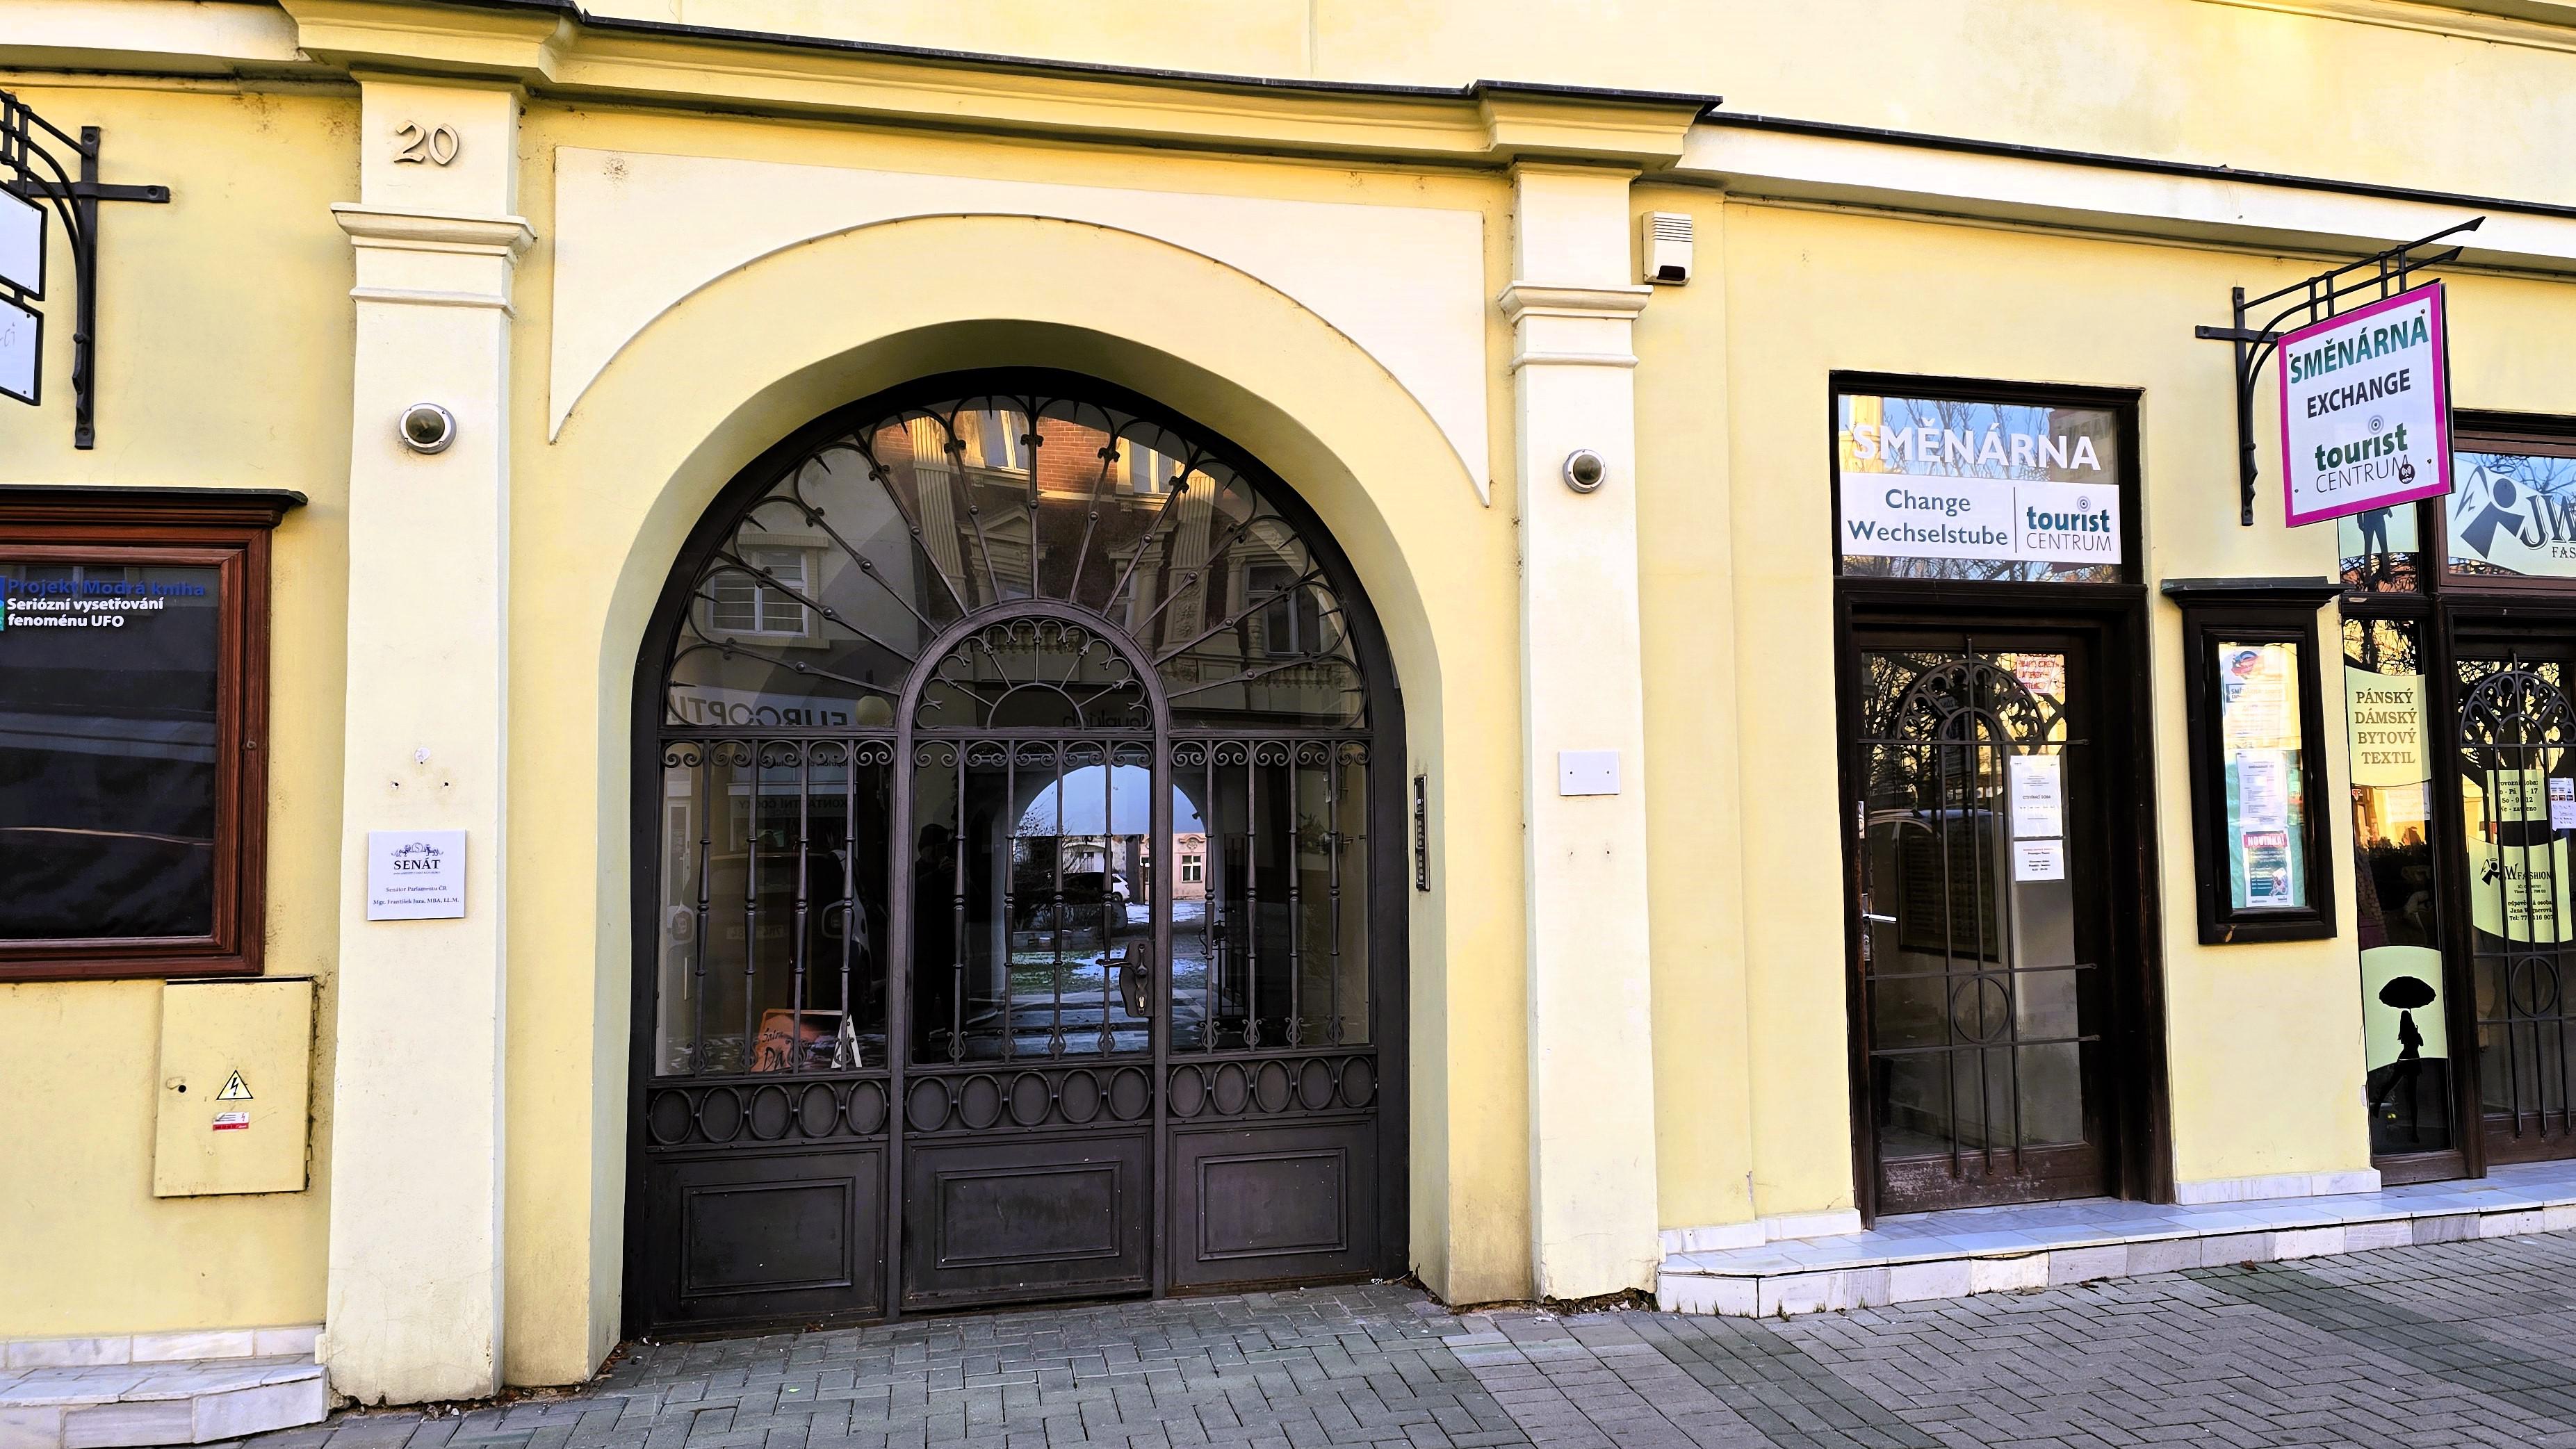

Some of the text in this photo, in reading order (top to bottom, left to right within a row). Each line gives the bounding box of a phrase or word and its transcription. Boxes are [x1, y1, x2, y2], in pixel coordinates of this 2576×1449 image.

[393, 120, 459, 166] 20
[2290, 316, 2429, 384] SMĚNÁRNA
[2307, 368, 2411, 418] EXCHANGE
[1852, 418, 2101, 470] SMĚNÁRNA
[2315, 423, 2408, 472] tourist
[2316, 455, 2408, 493] CENTRUM
[1885, 489, 1971, 516] Change
[2027, 505, 2110, 532] tourist
[1848, 519, 2008, 546] Wechselstube
[2026, 532, 2112, 551] CENTRUM
[8, 578, 204, 596] Projekt Modrá kniha
[7, 598, 71, 610] Seriózní
[8, 614, 124, 627] fenoménu UFO
[2356, 687, 2413, 703] PÁNSKÝ
[2354, 707, 2417, 723] DÁMSKÝ
[2357, 728, 2417, 744] BYTOVÝ
[2361, 751, 2415, 764] TEXTIL
[393, 857, 441, 870] SENÁT
